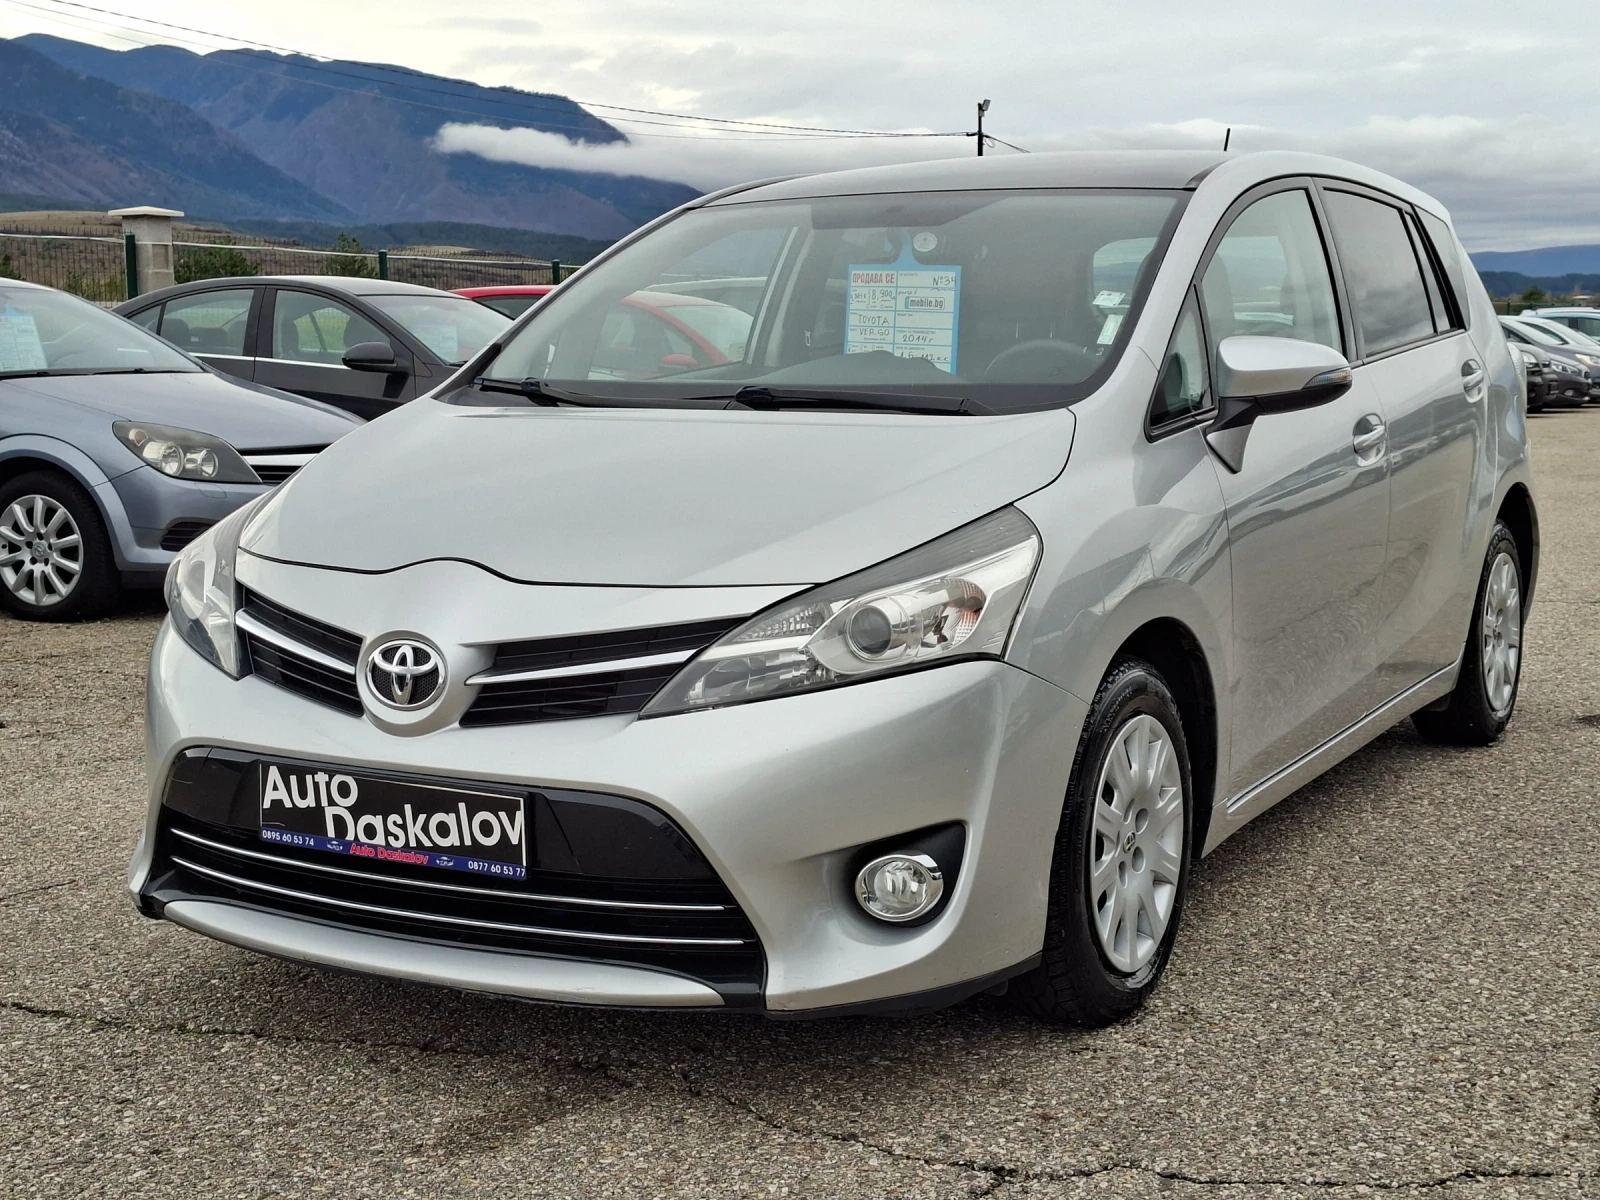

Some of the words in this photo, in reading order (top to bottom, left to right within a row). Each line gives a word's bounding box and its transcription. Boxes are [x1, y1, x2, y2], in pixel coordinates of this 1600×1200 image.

[852, 273, 883, 284] ПРОДАВА
[885, 273, 895, 284] СЕ
[910, 298, 944, 309] mobile.bg
[858, 314, 890, 326] TOYOTA
[263, 766, 358, 808] Auto
[324, 802, 523, 848] Daskalov
[262, 830, 281, 840] 0895
[282, 834, 292, 843] 60
[293, 836, 303, 845] 53
[305, 838, 314, 846] 74
[350, 843, 376, 857] Auto
[377, 846, 429, 864] Daskalov
[468, 861, 488, 872] 0877
[490, 864, 501, 873] 60
[503, 866, 513, 875] 53
[516, 868, 526, 877] 77
